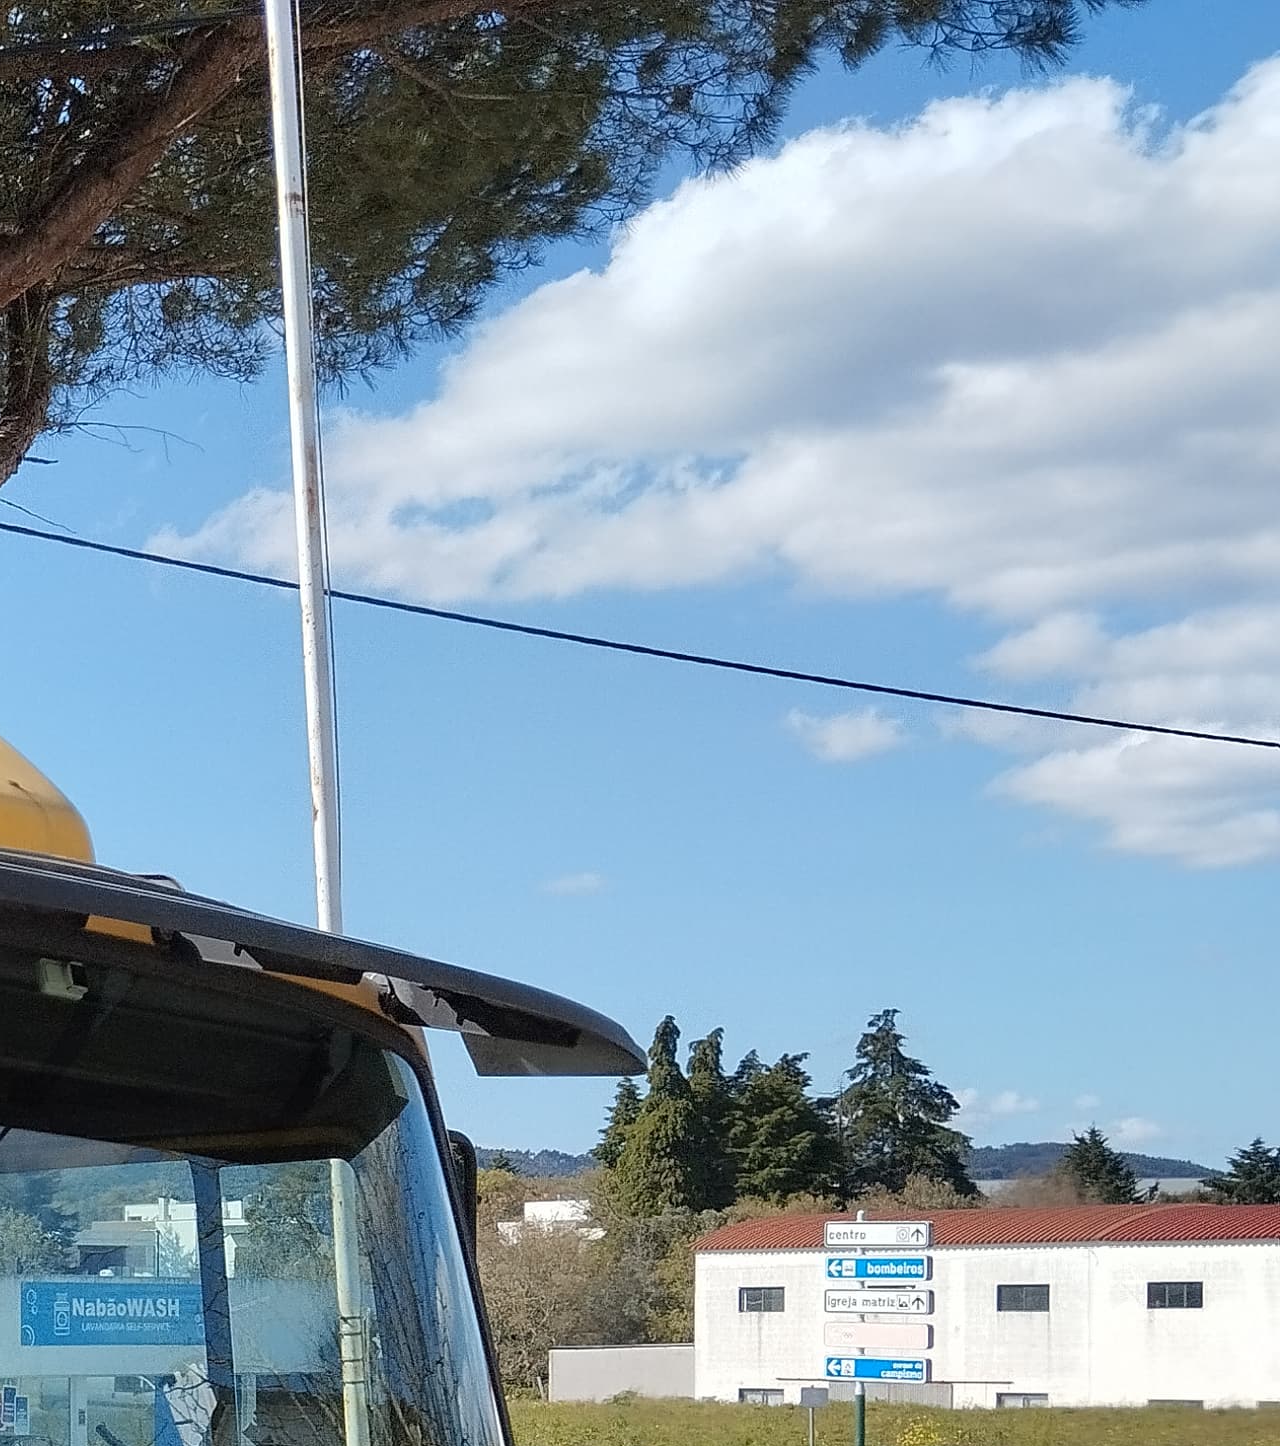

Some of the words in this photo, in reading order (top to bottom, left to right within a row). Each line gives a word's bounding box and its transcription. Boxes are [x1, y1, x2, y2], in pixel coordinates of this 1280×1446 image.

[828, 1229, 867, 1240] centro
[866, 1261, 924, 1276] bombeiros
[71, 1297, 181, 1318] NabãoWASH
[827, 1295, 858, 1308] igreja
[861, 1295, 897, 1307] matriz
